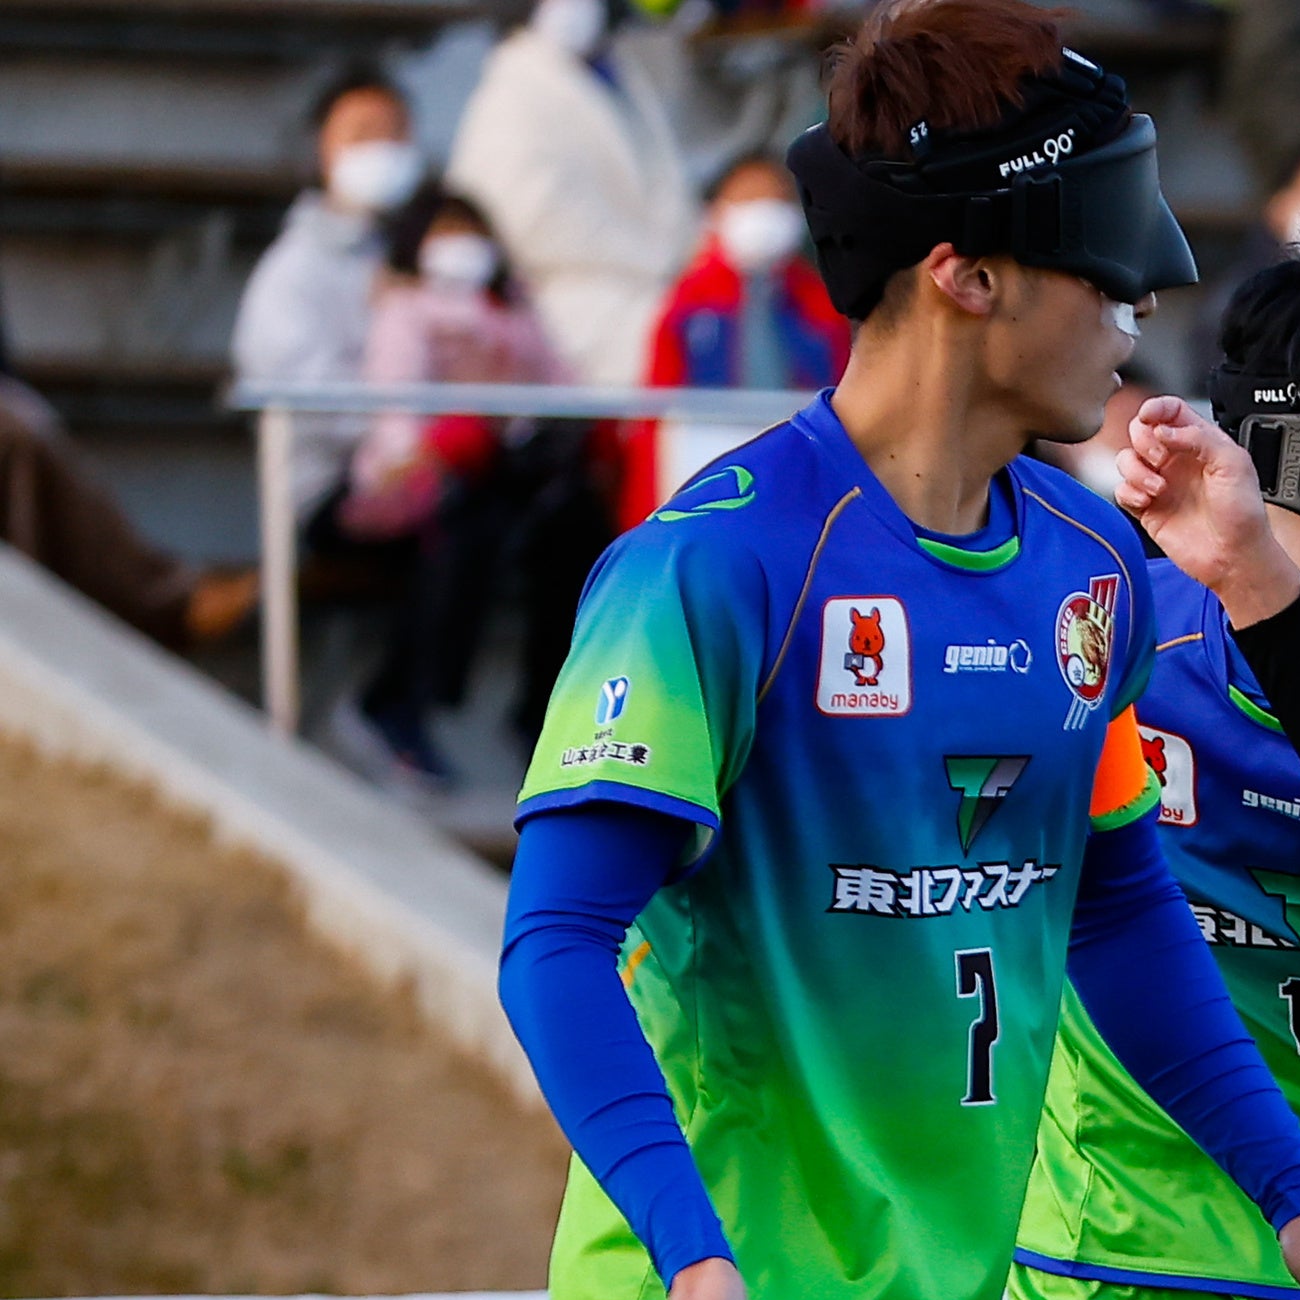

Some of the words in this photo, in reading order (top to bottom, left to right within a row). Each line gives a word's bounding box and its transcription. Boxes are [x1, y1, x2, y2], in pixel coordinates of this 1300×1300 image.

[943, 639, 1009, 674] genio
[830, 691, 899, 711] manaby
[828, 859, 1061, 918] 東北ファスナー
[954, 946, 1000, 1106] 7
